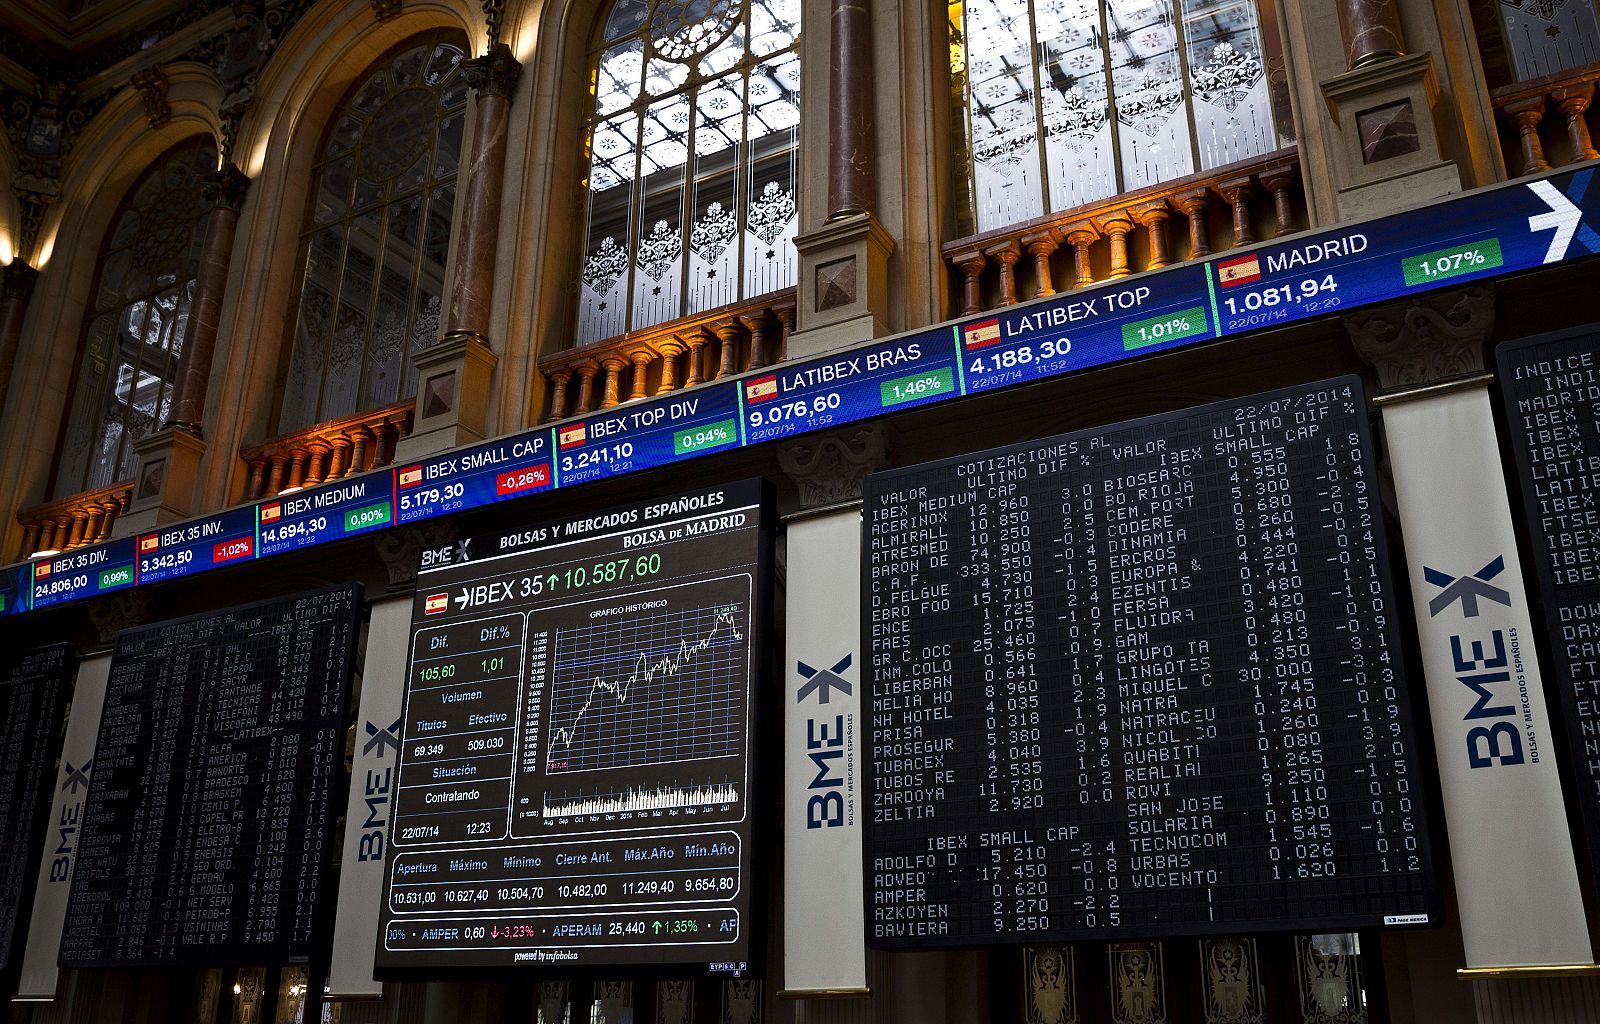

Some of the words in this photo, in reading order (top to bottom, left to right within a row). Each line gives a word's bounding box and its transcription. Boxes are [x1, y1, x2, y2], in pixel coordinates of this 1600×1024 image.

[1267, 234, 1368, 273] MADRID
[1420, 250, 1484, 277] 1,07%
[1225, 274, 1337, 316] 1.081,94
[1006, 299, 1098, 337] LATIBEX
[1103, 286, 1149, 312] TOP
[1228, 308, 1287, 330] 22/07/14
[1303, 297, 1340, 313] 12:20
[1137, 317, 1190, 341] 1,01%
[970, 337, 1071, 374] 4.188,30
[782, 358, 861, 392] LATIBEX
[867, 343, 921, 371] BRAS
[973, 370, 1022, 389] 22/07/14
[1036, 360, 1066, 373] 11:52
[893, 376, 941, 399] 1,46%
[750, 393, 841, 427] 9.076,60
[1234, 386, 1352, 422] 22/07/2014
[590, 416, 627, 439] IBEX
[631, 408, 665, 428] TOP
[671, 399, 698, 419] DIV
[752, 423, 795, 440] 22/07/14
[807, 415, 833, 427] 11:52
[1524, 407, 1576, 429] IBEX
[683, 428, 726, 448] 0,94%
[426, 459, 458, 479] IBEX
[461, 448, 509, 471] SMALL
[513, 438, 543, 457] CAP
[562, 442, 632, 472] 3.241,10
[958, 442, 1078, 476] COTIZACIONES
[502, 470, 544, 489] -0,26%
[563, 468, 600, 483] 22/07/14
[610, 461, 632, 472] 12:21
[284, 497, 312, 516] IBEX
[315, 483, 365, 508] MEDIUM
[401, 483, 464, 509] 5.179,30
[873, 502, 908, 521] IBEX
[919, 491, 977, 513] MEDIUM
[989, 484, 1017, 499] CAP
[881, 487, 927, 505] VALOR
[351, 509, 383, 526] 0,90%
[402, 507, 433, 520] 22/07/14
[442, 501, 462, 511] 12:20
[499, 528, 547, 549] BOLSAS
[551, 526, 559, 538] Y
[565, 510, 637, 535] MERCADOS
[644, 491, 724, 519] ESPAÑOLES
[262, 517, 326, 543] 14.694,30
[872, 513, 948, 535] ACERINOX
[1542, 510, 1598, 531] FTSE
[161, 532, 185, 547] IBEX
[187, 527, 200, 540] 35
[202, 521, 223, 537] INV.
[623, 530, 666, 549] BOLSA
[685, 513, 746, 536] MADRID
[872, 526, 947, 550] ALMIRALL
[218, 542, 248, 557] -1,02%
[262, 542, 290, 554] 22/07/14
[298, 536, 315, 546] 12:22
[53, 559, 74, 573] IBEX
[77, 556, 88, 568] 35
[90, 550, 108, 564] DIV.
[142, 550, 192, 572] 3.342,50
[1110, 546, 1176, 569] ERCROS
[103, 571, 128, 585] 0,99%
[172, 566, 187, 575] 12:21
[35, 575, 87, 598] 24.806,00
[468, 576, 514, 608] IBEX
[520, 575, 543, 598] 35
[565, 553, 661, 590] 10.587,60
[296, 589, 352, 609] 22/07/2014
[430, 635, 449, 649] Dif.
[1508, 627, 1524, 673] ESPAÑOLES
[222, 664, 254, 676] REPSOL
[420, 664, 455, 681] 105,60
[481, 657, 504, 673] 1,01
[219, 683, 262, 699] SANTANDE
[873, 676, 952, 696] LIBERBAN
[218, 695, 260, 710] TECNICAS
[442, 691, 482, 703] Volumen
[1517, 675, 1533, 722] MERCADOS
[213, 717, 258, 731] VISCOFAN
[469, 712, 507, 725] Efectivo
[415, 744, 443, 756] 69.349
[467, 737, 503, 751] 509.030
[874, 738, 954, 758] PROSEGUR
[1526, 730, 1540, 764] BOLSAS
[208, 753, 247, 766] AMERICA
[433, 764, 477, 777] Situación
[203, 788, 242, 801] BRASKEM
[425, 790, 479, 803] Contratando
[875, 787, 945, 806] ZARDOYA
[544, 818, 554, 826] Aug
[559, 817, 569, 825] Sep
[590, 815, 599, 823] Nov
[620, 812, 632, 820] 2014
[685, 807, 696, 815] May
[703, 806, 713, 814] Jun
[875, 805, 935, 822] ZELTIA
[402, 826, 439, 839] 22/07/14
[467, 822, 491, 834] 12:23
[1129, 815, 1213, 834] SOLARIA
[685, 843, 735, 858] Mín.Año
[1130, 833, 1227, 852] TECNOCOM
[503, 856, 541, 868] Mínimo
[556, 854, 586, 865] Cierre
[590, 852, 612, 864] Ant.
[624, 847, 674, 861] Máx.Año
[398, 862, 437, 875] Apertura
[450, 859, 487, 871] Máximo
[498, 887, 543, 900] 10.504,70
[558, 884, 607, 898] 10.482,00
[623, 880, 674, 895] 11.249,40
[685, 877, 733, 891] 9.654,80
[394, 892, 436, 905] 10.531,00
[445, 890, 488, 903] 10.627,40
[875, 904, 948, 920] AZKOYEN
[183, 921, 229, 932] USIMINAS
[422, 929, 458, 940] AMPER
[465, 927, 485, 940] 0,60
[501, 926, 534, 939] -3,23%
[553, 924, 602, 937] APERAM
[609, 921, 645, 935] 25,440
[665, 920, 698, 934] 1,35%
[875, 922, 948, 937] BAVIERA
[515, 950, 537, 962] powered
[539, 950, 545, 962] by
[546, 950, 578, 962] infobolsa
